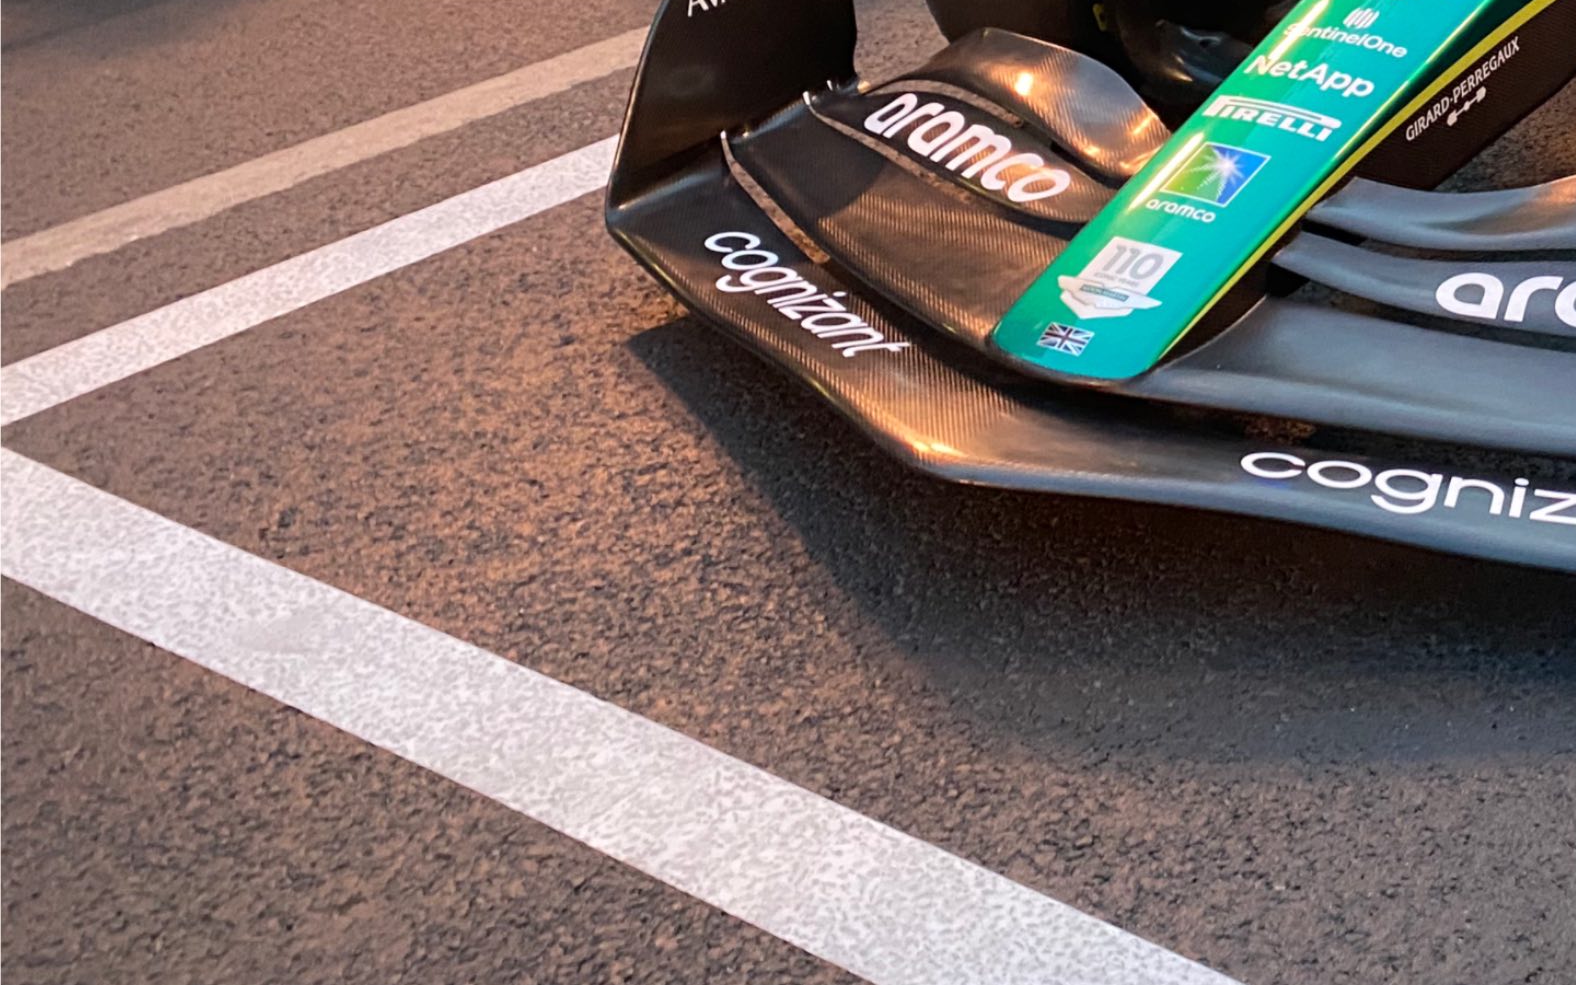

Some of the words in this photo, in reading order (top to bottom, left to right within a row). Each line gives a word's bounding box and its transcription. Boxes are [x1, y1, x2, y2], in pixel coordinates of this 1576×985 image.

[1284, 22, 1408, 58] SentinelOne
[1243, 54, 1376, 98] NetApp
[1201, 93, 1343, 142] PIRELLI
[864, 93, 1071, 202] aramco
[1146, 198, 1217, 224] aramco
[1102, 244, 1164, 280] 110
[704, 231, 910, 357] cognizant
